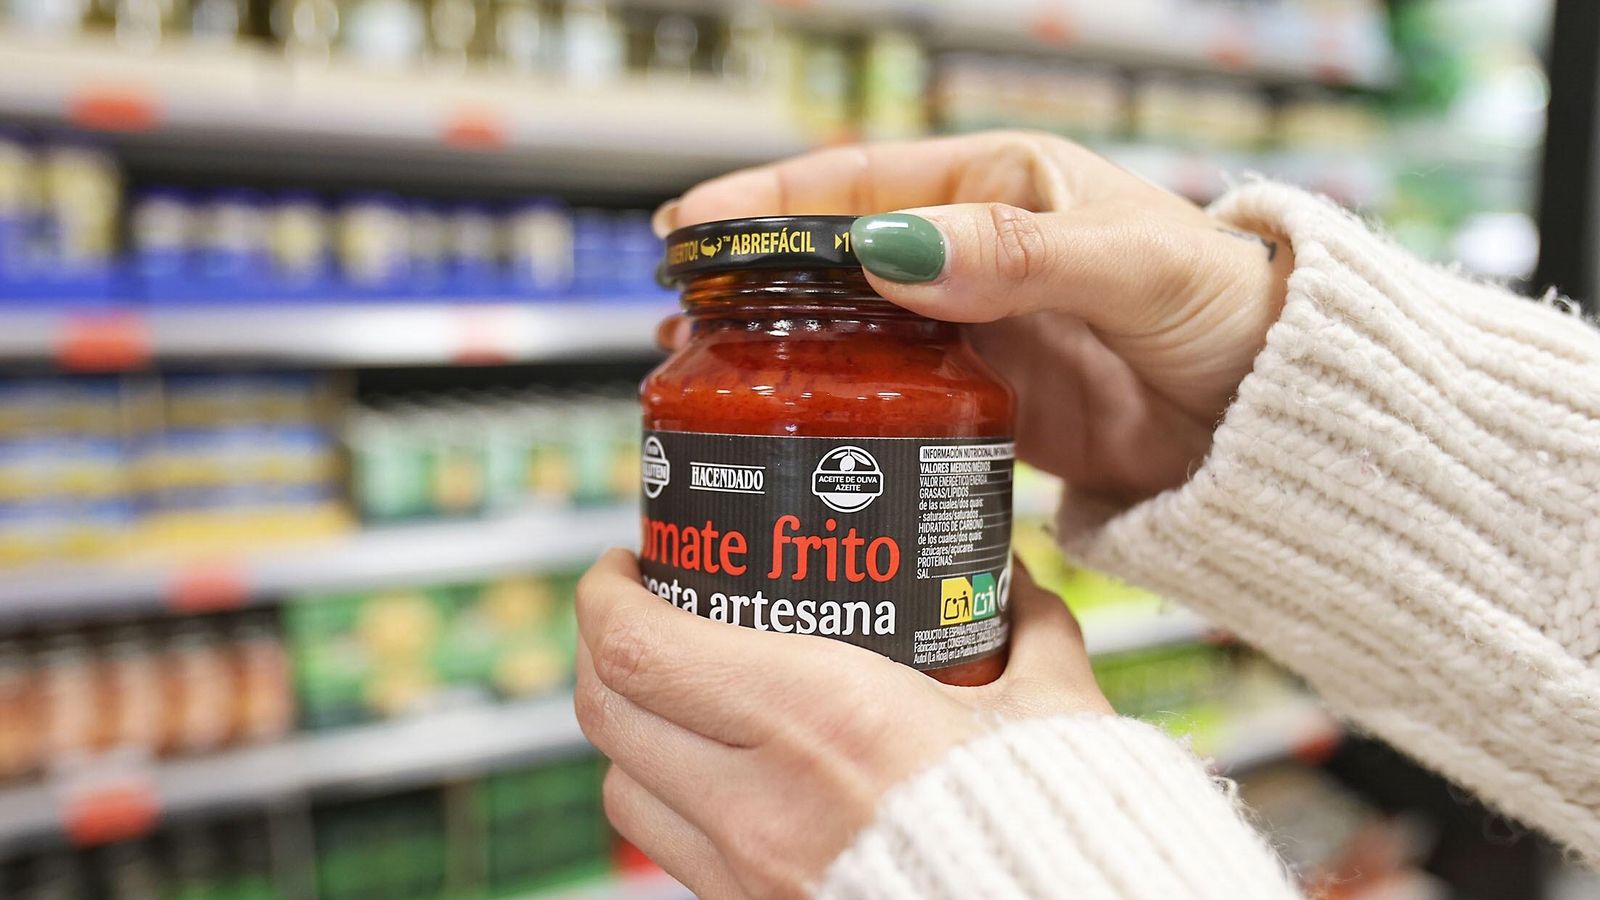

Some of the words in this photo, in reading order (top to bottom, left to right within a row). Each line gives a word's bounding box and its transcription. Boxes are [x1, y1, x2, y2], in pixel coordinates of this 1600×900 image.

[730, 227, 816, 256] ABREFÁCIL
[919, 462, 950, 474] VALORES
[691, 466, 765, 492] HACENDADO
[818, 475, 845, 484] ACEITE
[845, 475, 856, 484] DE
[856, 475, 878, 484] OLIVA
[919, 476, 939, 488] VALOR
[834, 484, 862, 492] AZEITE
[918, 499, 928, 511] de
[928, 499, 939, 511] las
[918, 521, 950, 534] HIDRATOS
[950, 520, 959, 532] DE
[917, 533, 927, 545] de
[927, 533, 938, 545] los
[767, 513, 901, 583] frito
[916, 568, 930, 579] SAL
[709, 590, 897, 636] artesana
